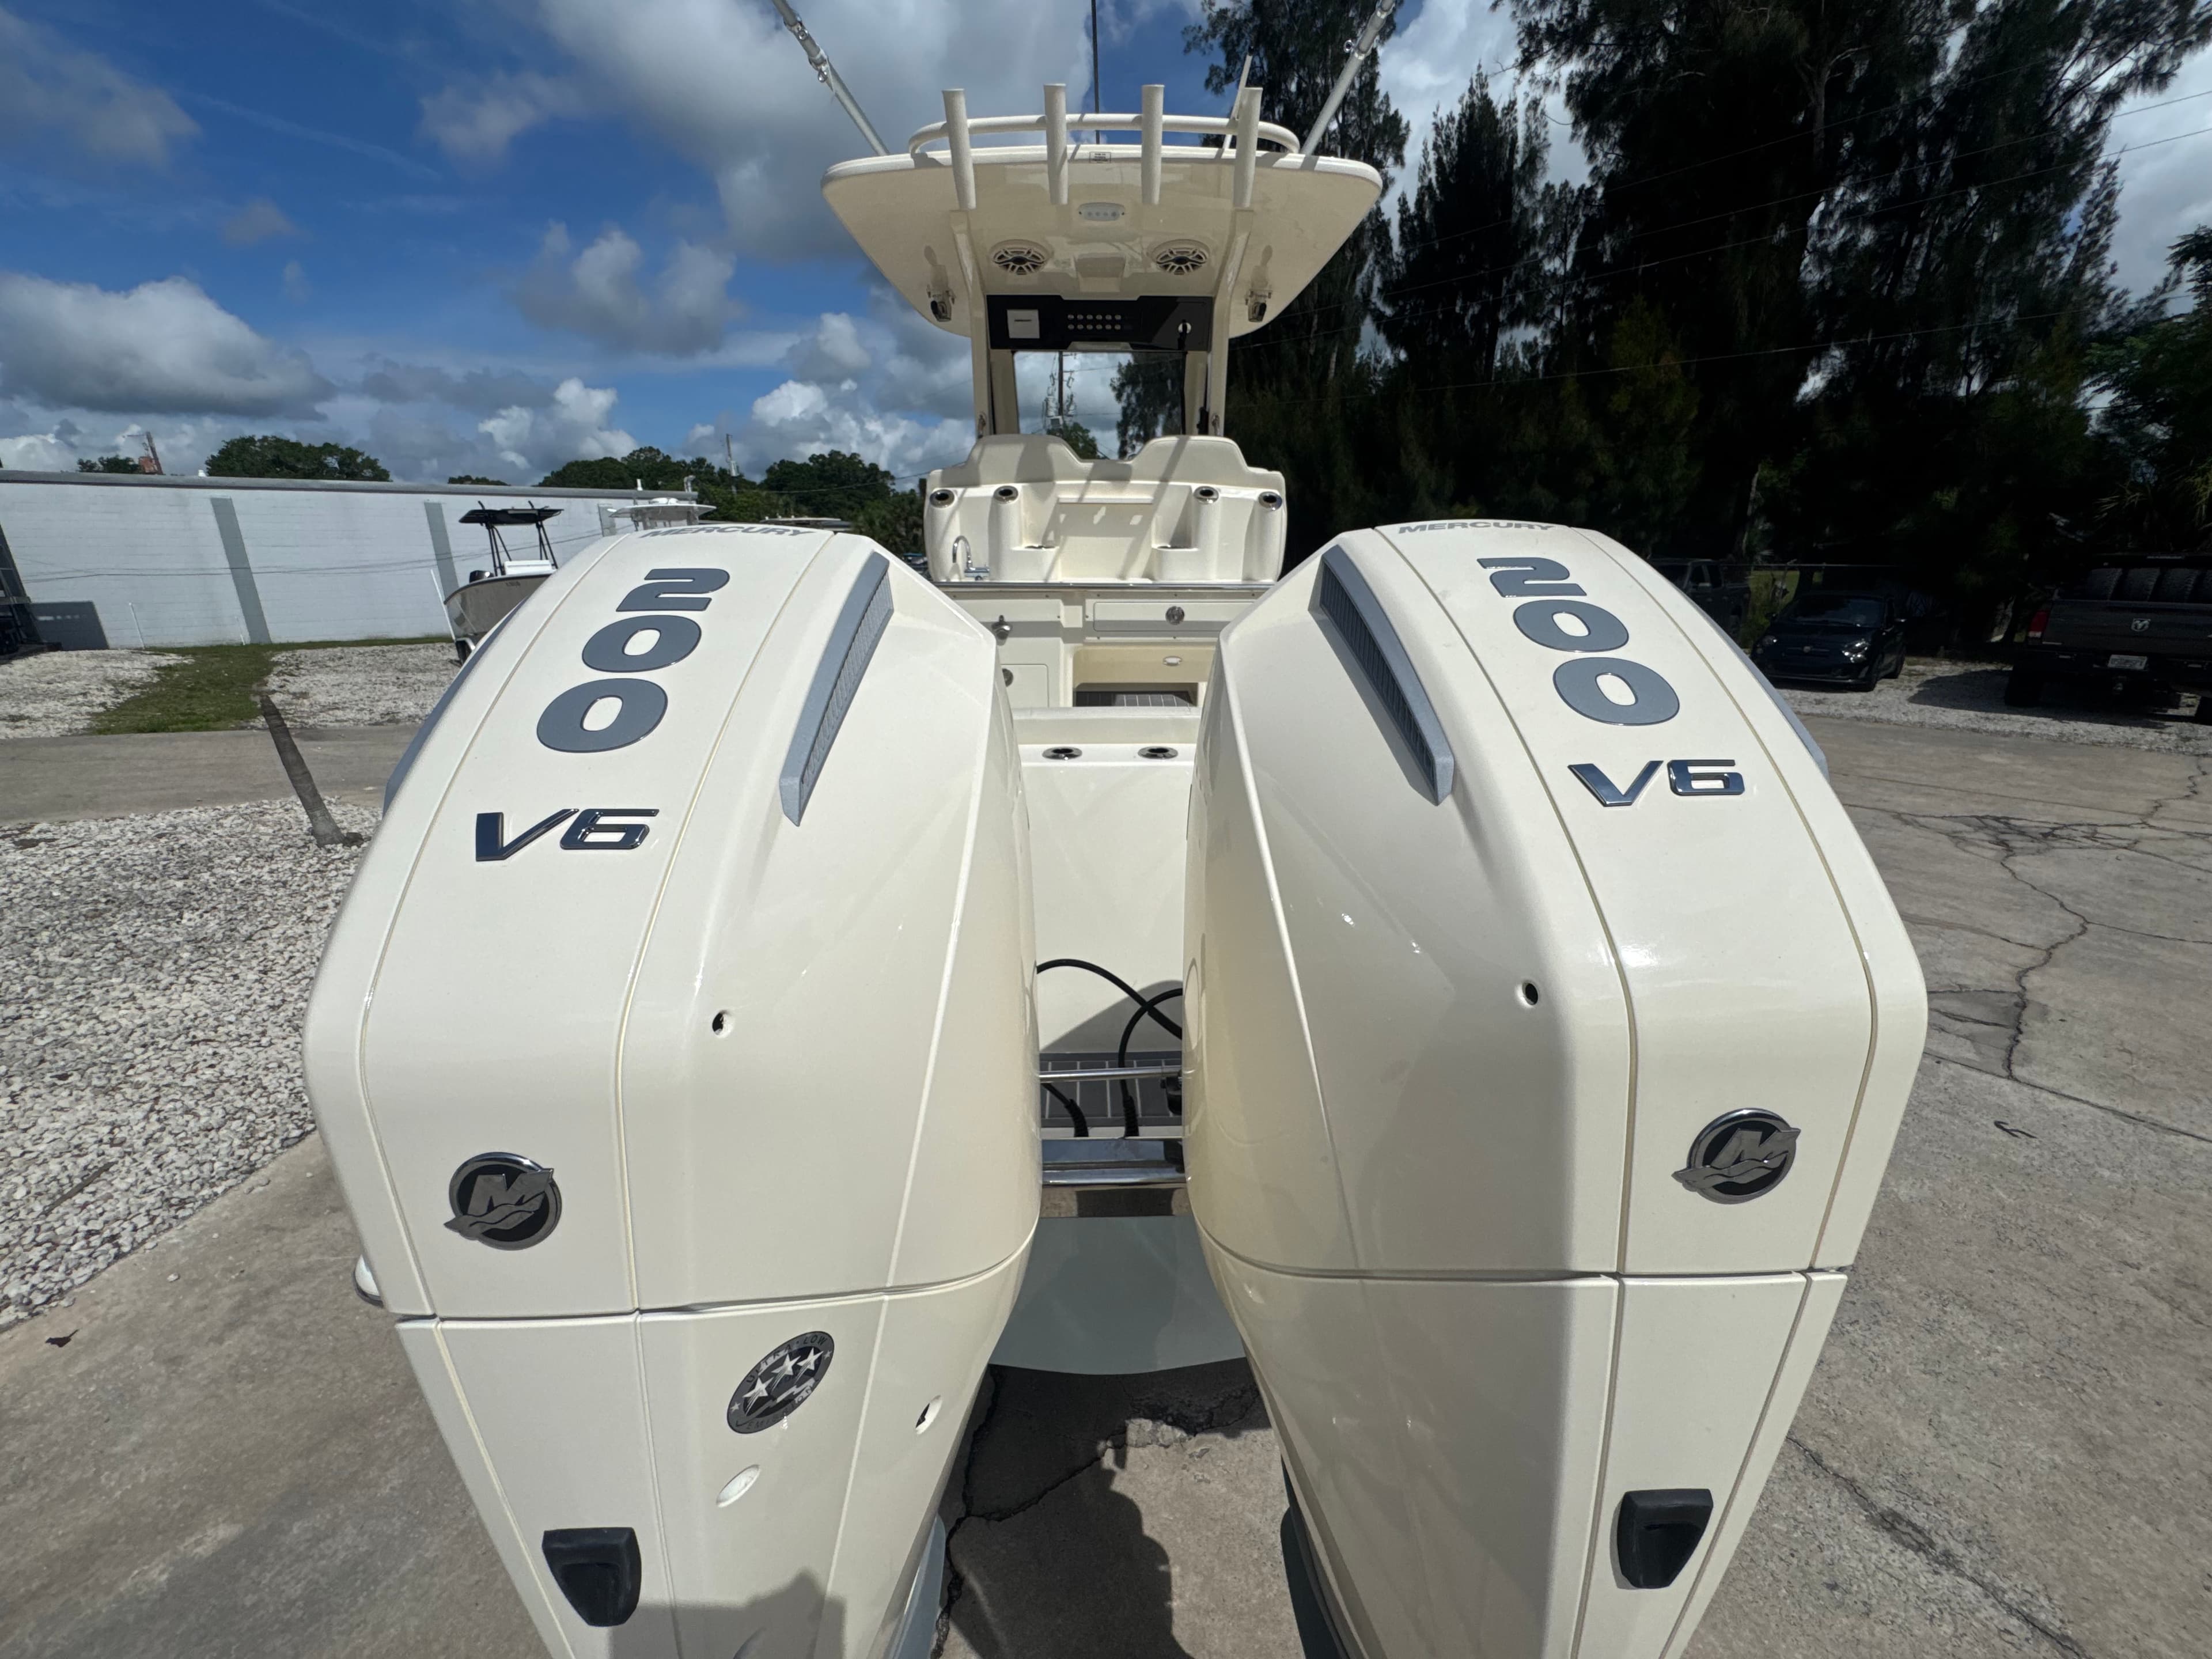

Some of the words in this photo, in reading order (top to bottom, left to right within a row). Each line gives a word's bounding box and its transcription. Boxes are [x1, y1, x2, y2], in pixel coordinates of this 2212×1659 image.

[638, 526, 817, 539] MERCURY
[1398, 521, 1556, 534] MERCURY
[536, 567, 730, 753] 200
[1477, 556, 1680, 726] 200
[1567, 759, 1745, 808] V6
[475, 808, 660, 862] V6
[803, 1335, 827, 1346] LOW
